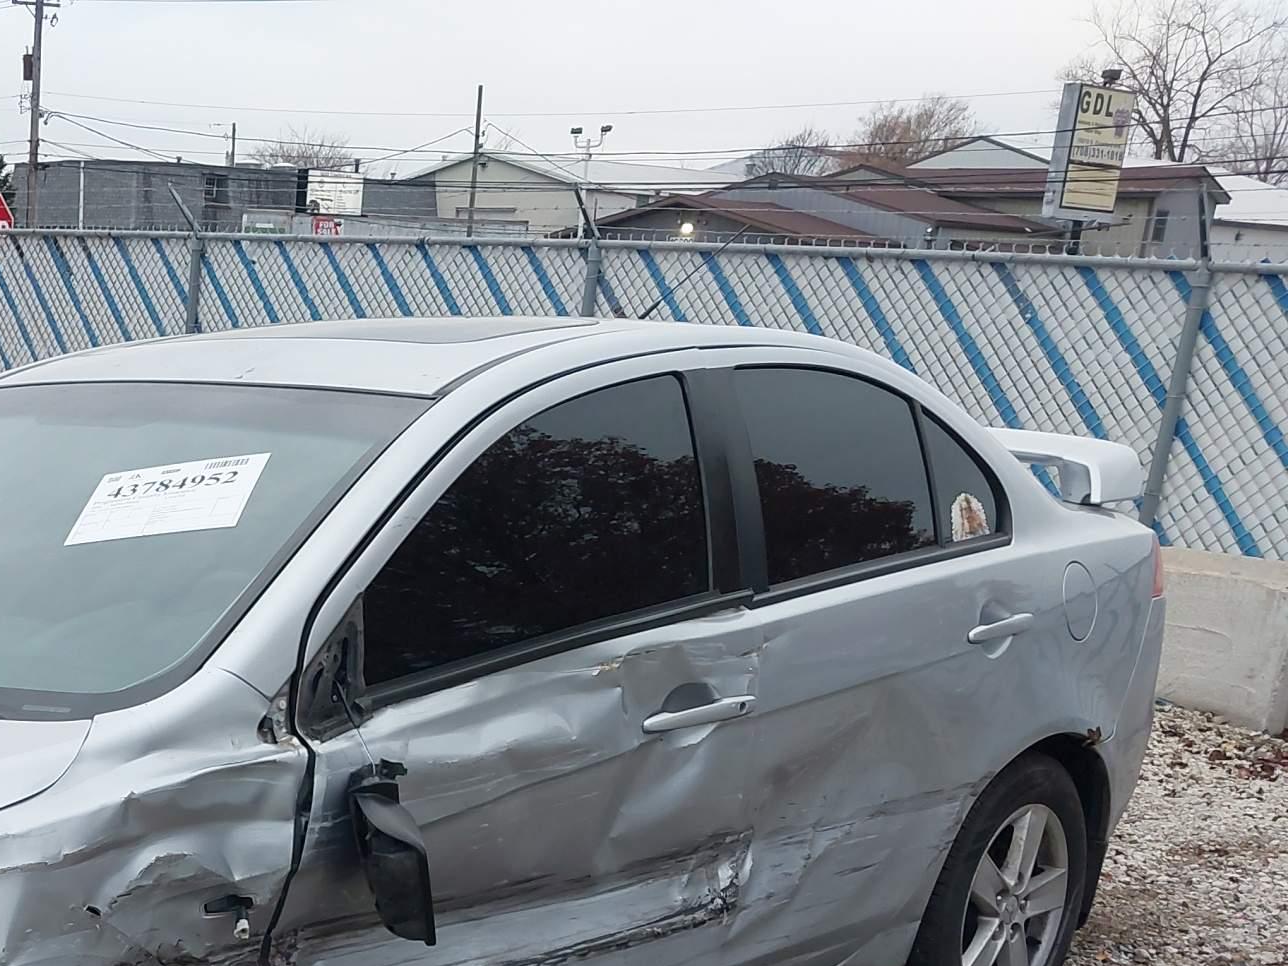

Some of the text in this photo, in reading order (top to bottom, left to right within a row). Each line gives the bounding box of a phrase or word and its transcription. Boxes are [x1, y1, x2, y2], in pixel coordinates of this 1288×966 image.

[1080, 90, 1114, 118] GDL
[318, 220, 335, 229] FOR
[107, 470, 240, 499] 43784952
